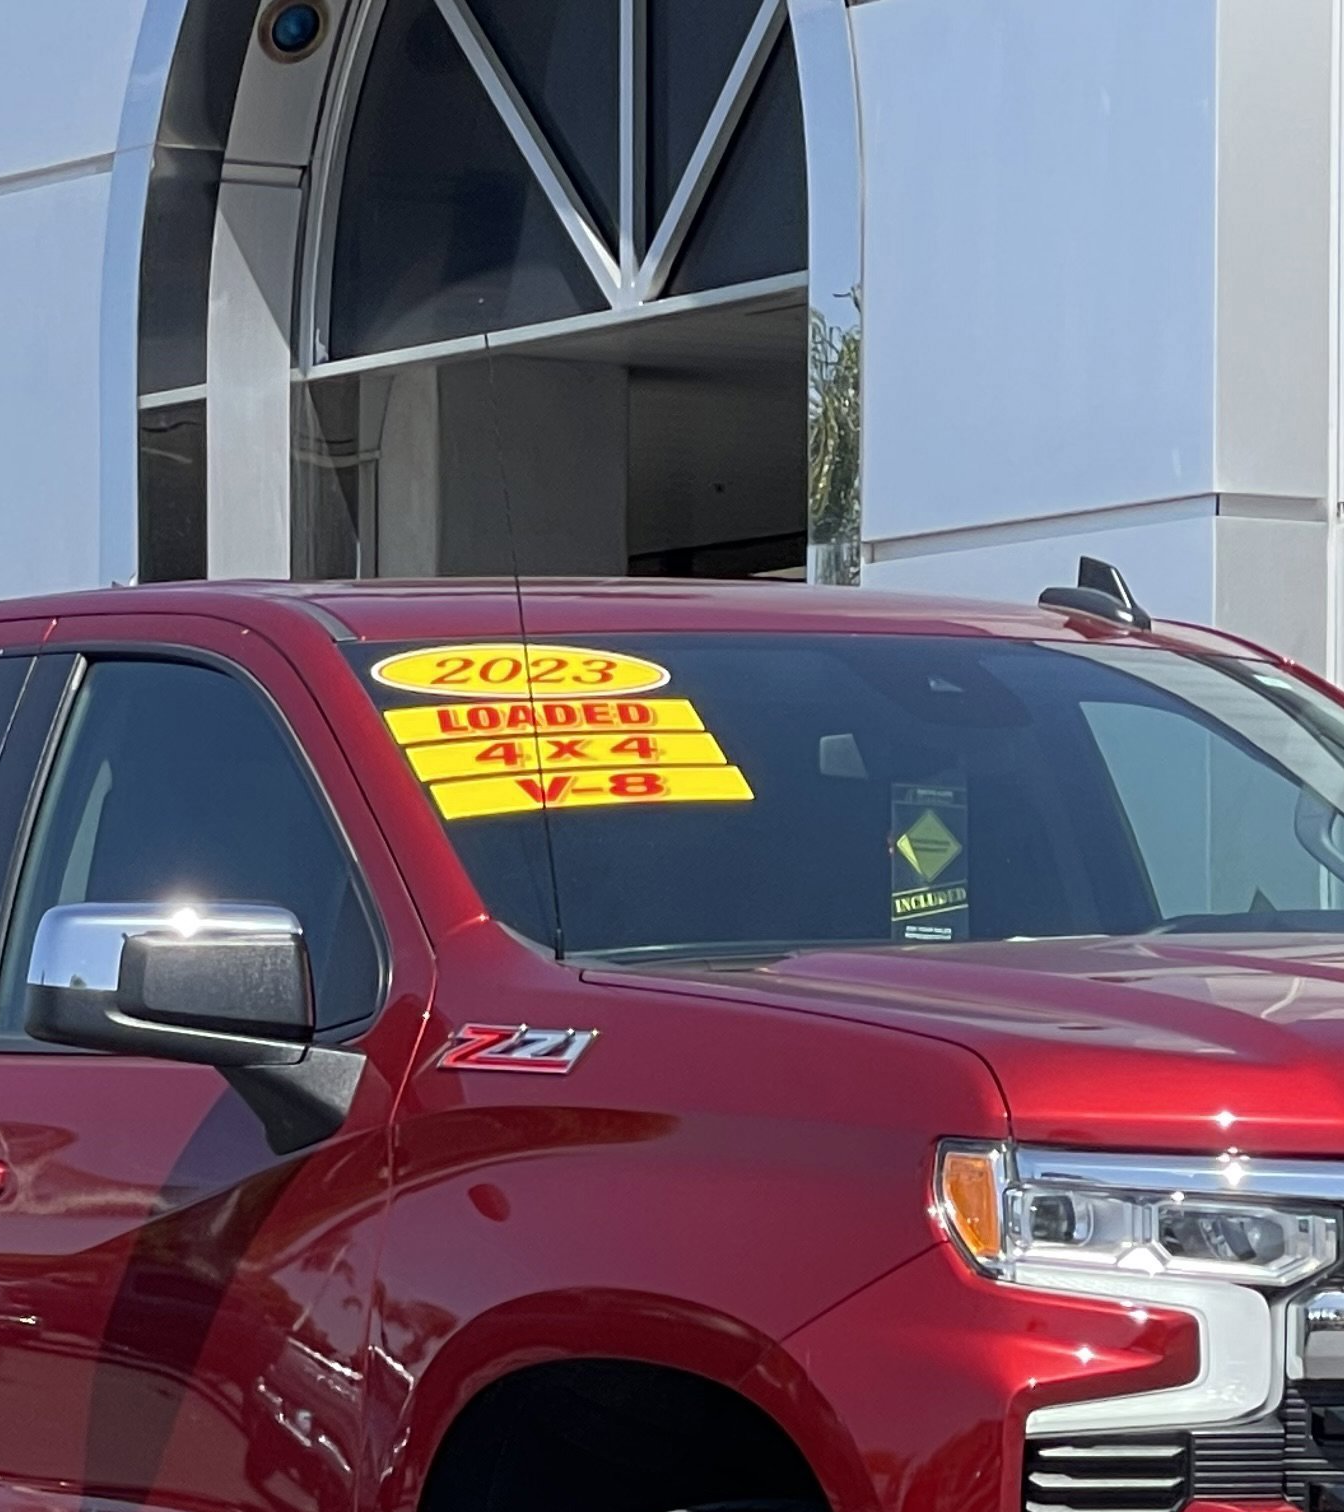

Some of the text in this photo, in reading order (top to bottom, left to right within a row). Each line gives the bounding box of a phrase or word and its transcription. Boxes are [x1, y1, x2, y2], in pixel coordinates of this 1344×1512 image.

[430, 657, 619, 686] 2023
[436, 701, 656, 736] LOADED
[474, 741, 528, 768] 4
[609, 735, 663, 762] 4
[514, 771, 668, 804] V-8
[895, 886, 967, 914] INCLUDED
[436, 1023, 597, 1075] Z71
